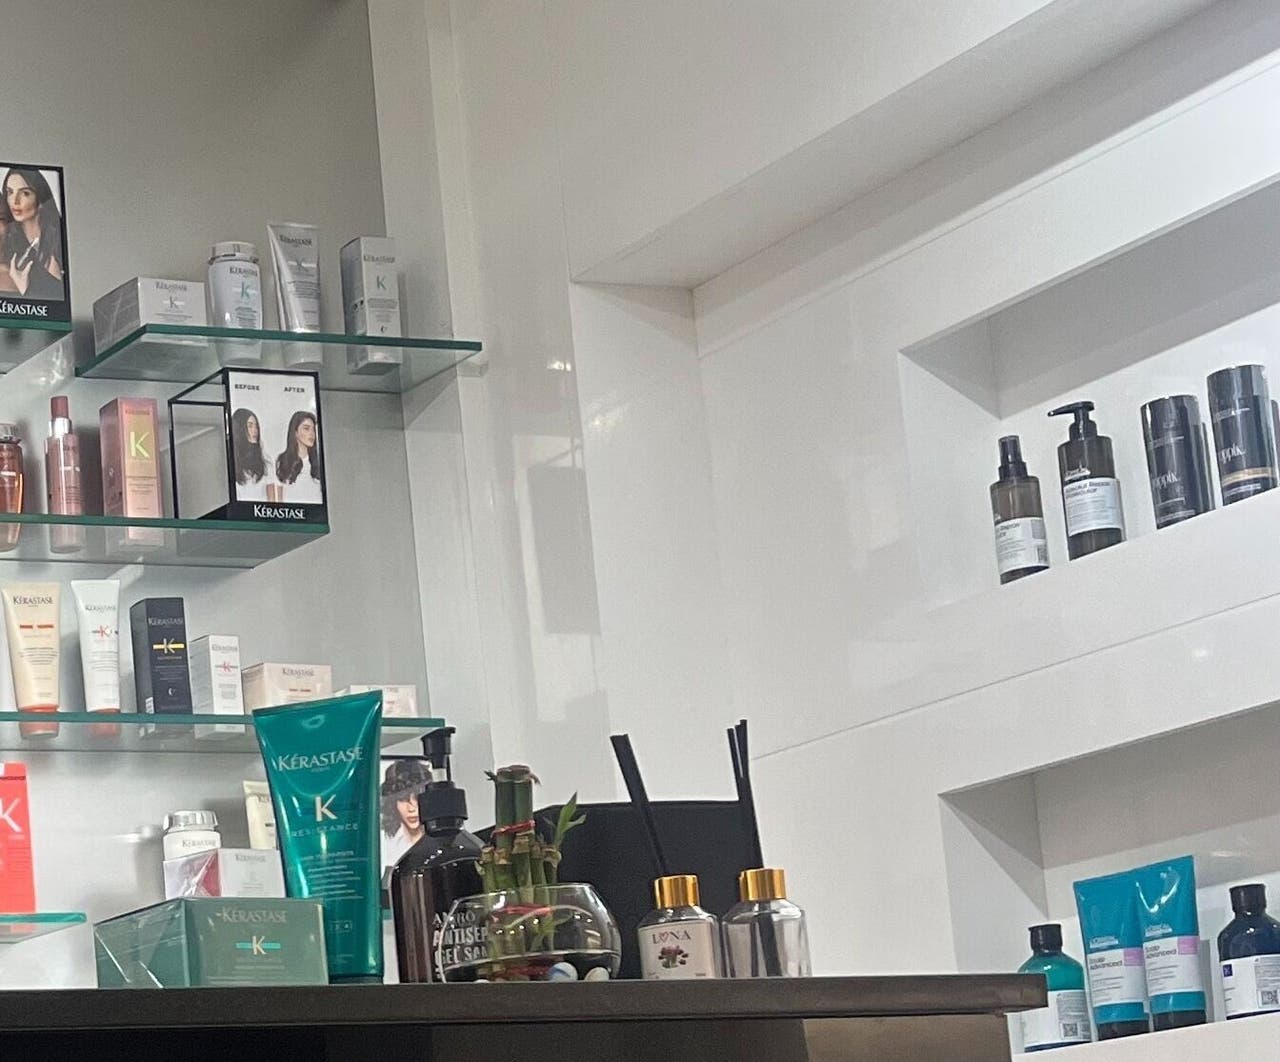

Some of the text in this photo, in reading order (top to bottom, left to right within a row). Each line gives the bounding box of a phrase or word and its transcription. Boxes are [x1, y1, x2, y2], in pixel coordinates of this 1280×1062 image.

[129, 431, 150, 460] K
[254, 504, 306, 520] KÉRASTASE
[278, 746, 366, 772] KÉRASTASE
[315, 793, 339, 822] K
[222, 907, 288, 923] KÉRASTASE
